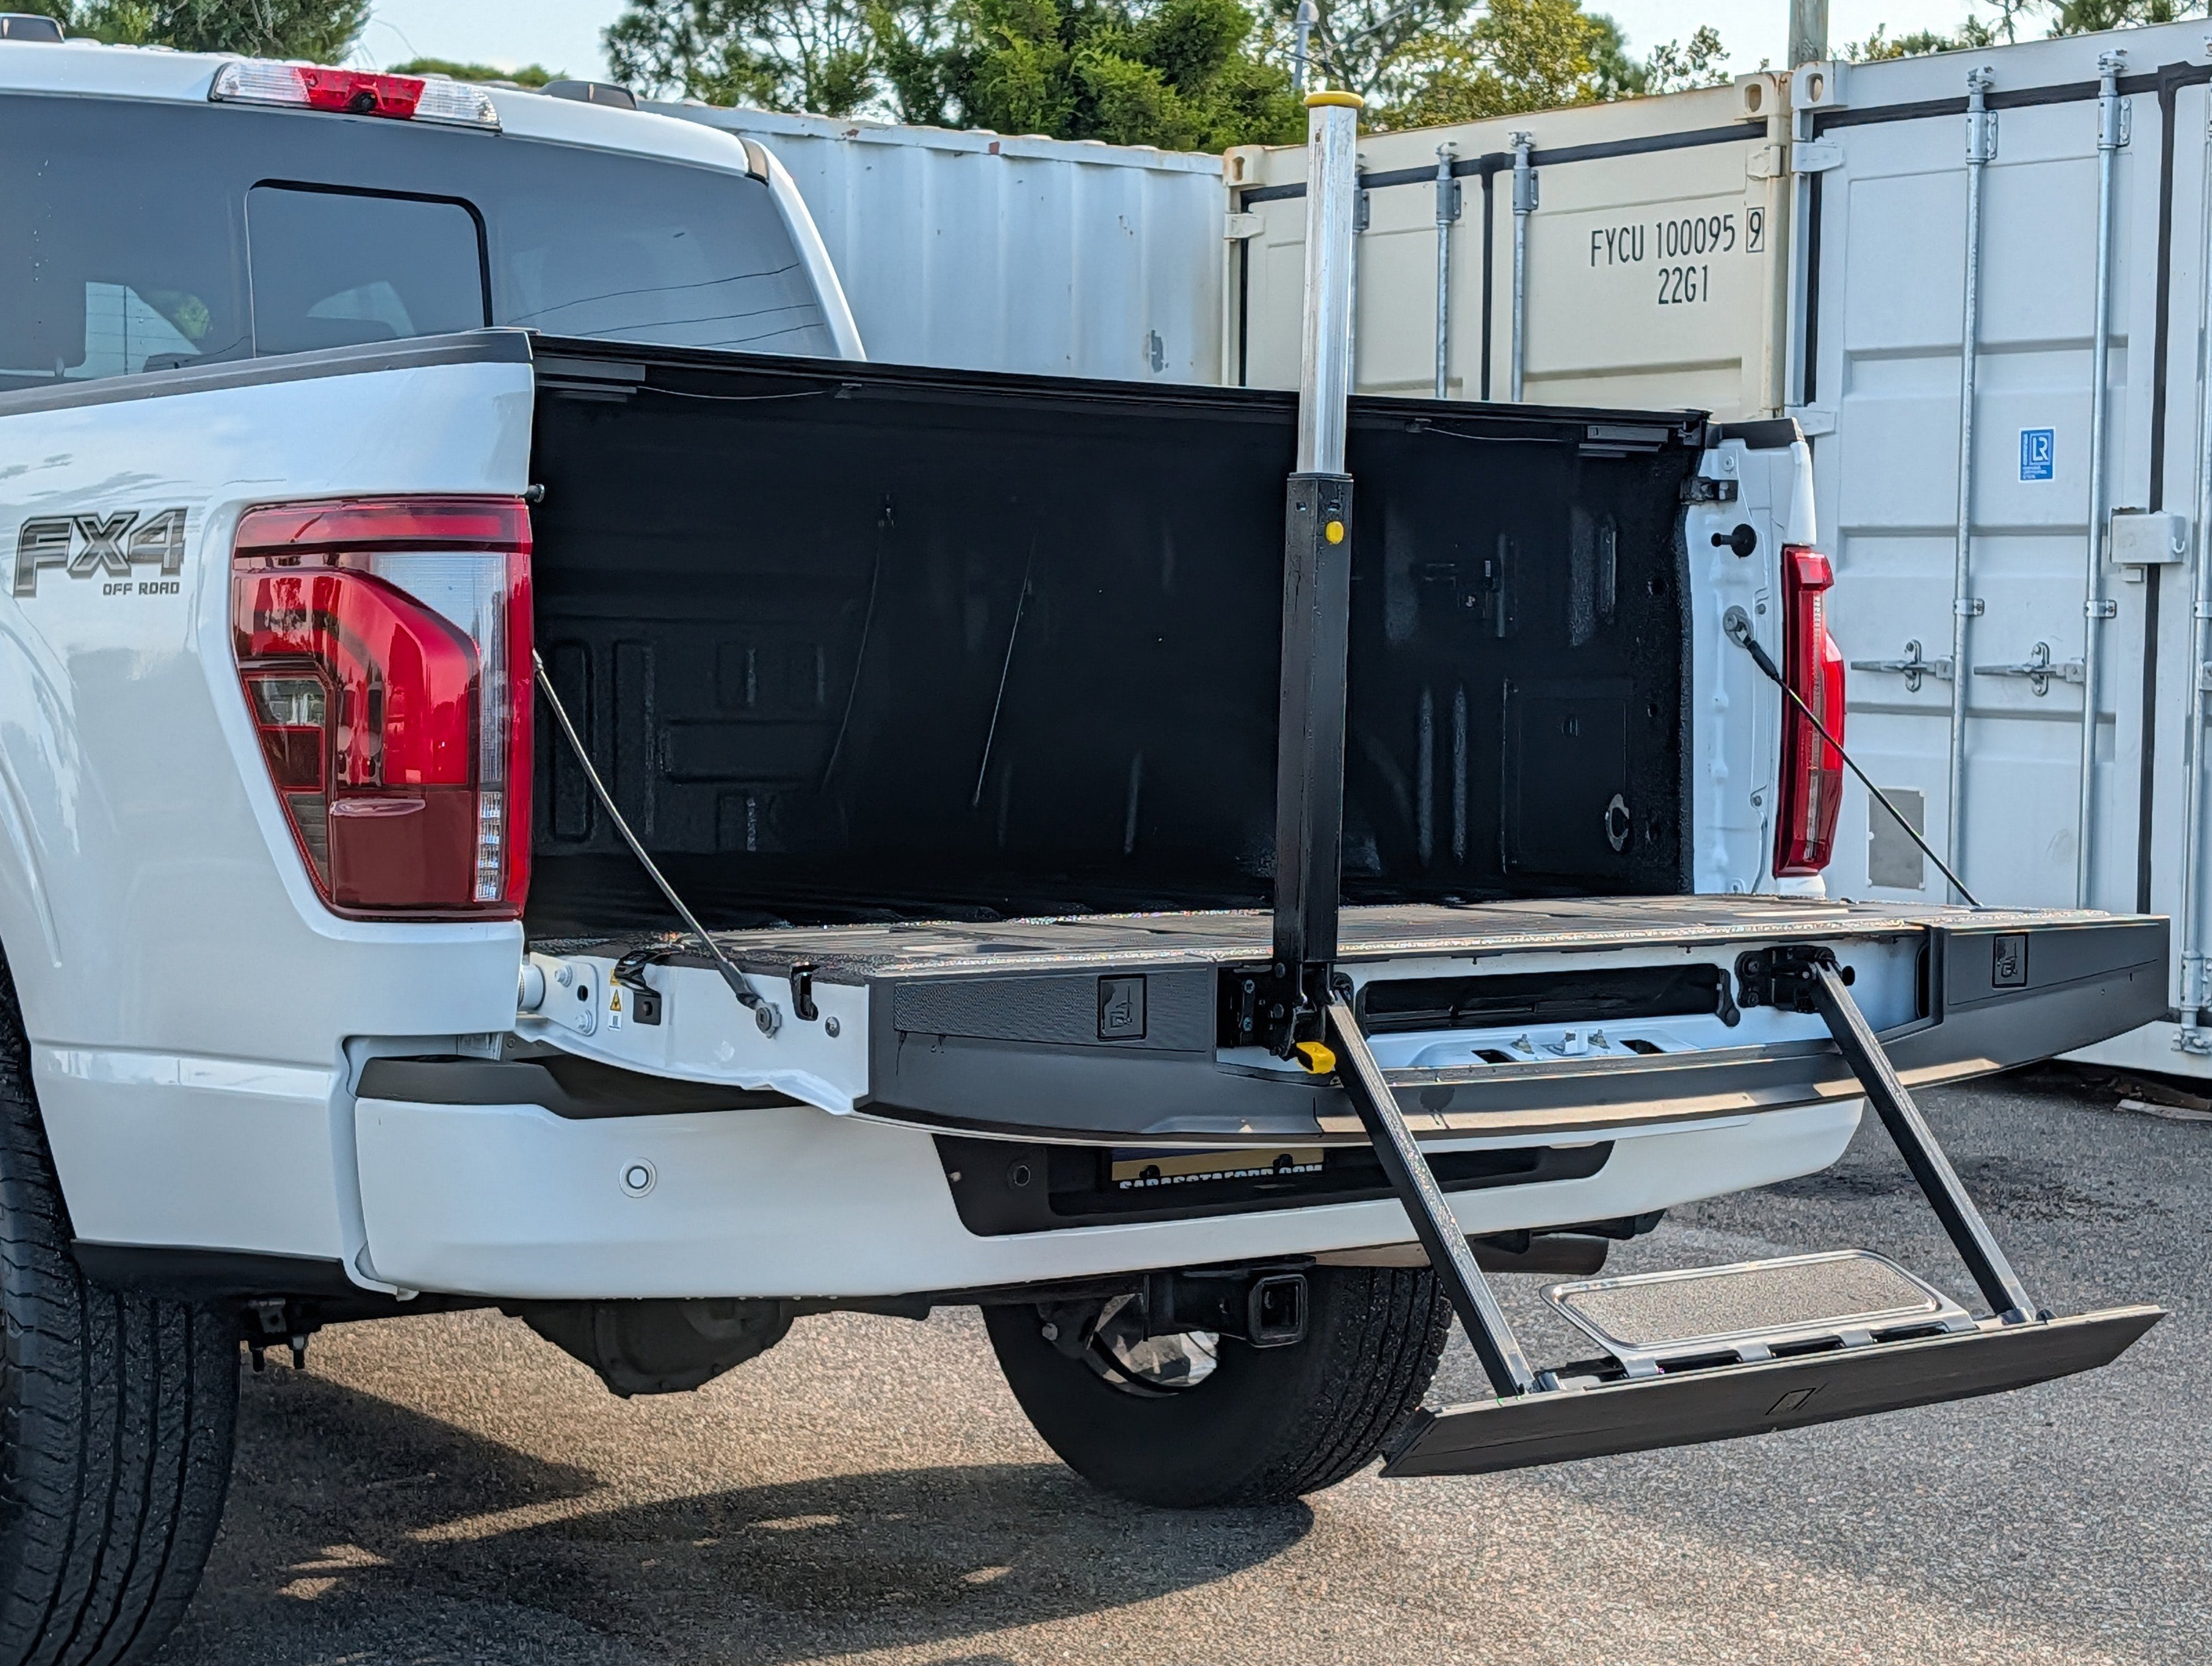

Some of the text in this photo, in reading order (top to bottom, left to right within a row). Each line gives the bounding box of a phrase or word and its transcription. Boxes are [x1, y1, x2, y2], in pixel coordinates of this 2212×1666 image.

[1591, 210, 1762, 267] FYCU 100095 9
[1658, 264, 1708, 304] 22G1
[2033, 437, 2049, 461] LR
[14, 506, 188, 598] FX4
[102, 581, 180, 595] OFF ROAD
